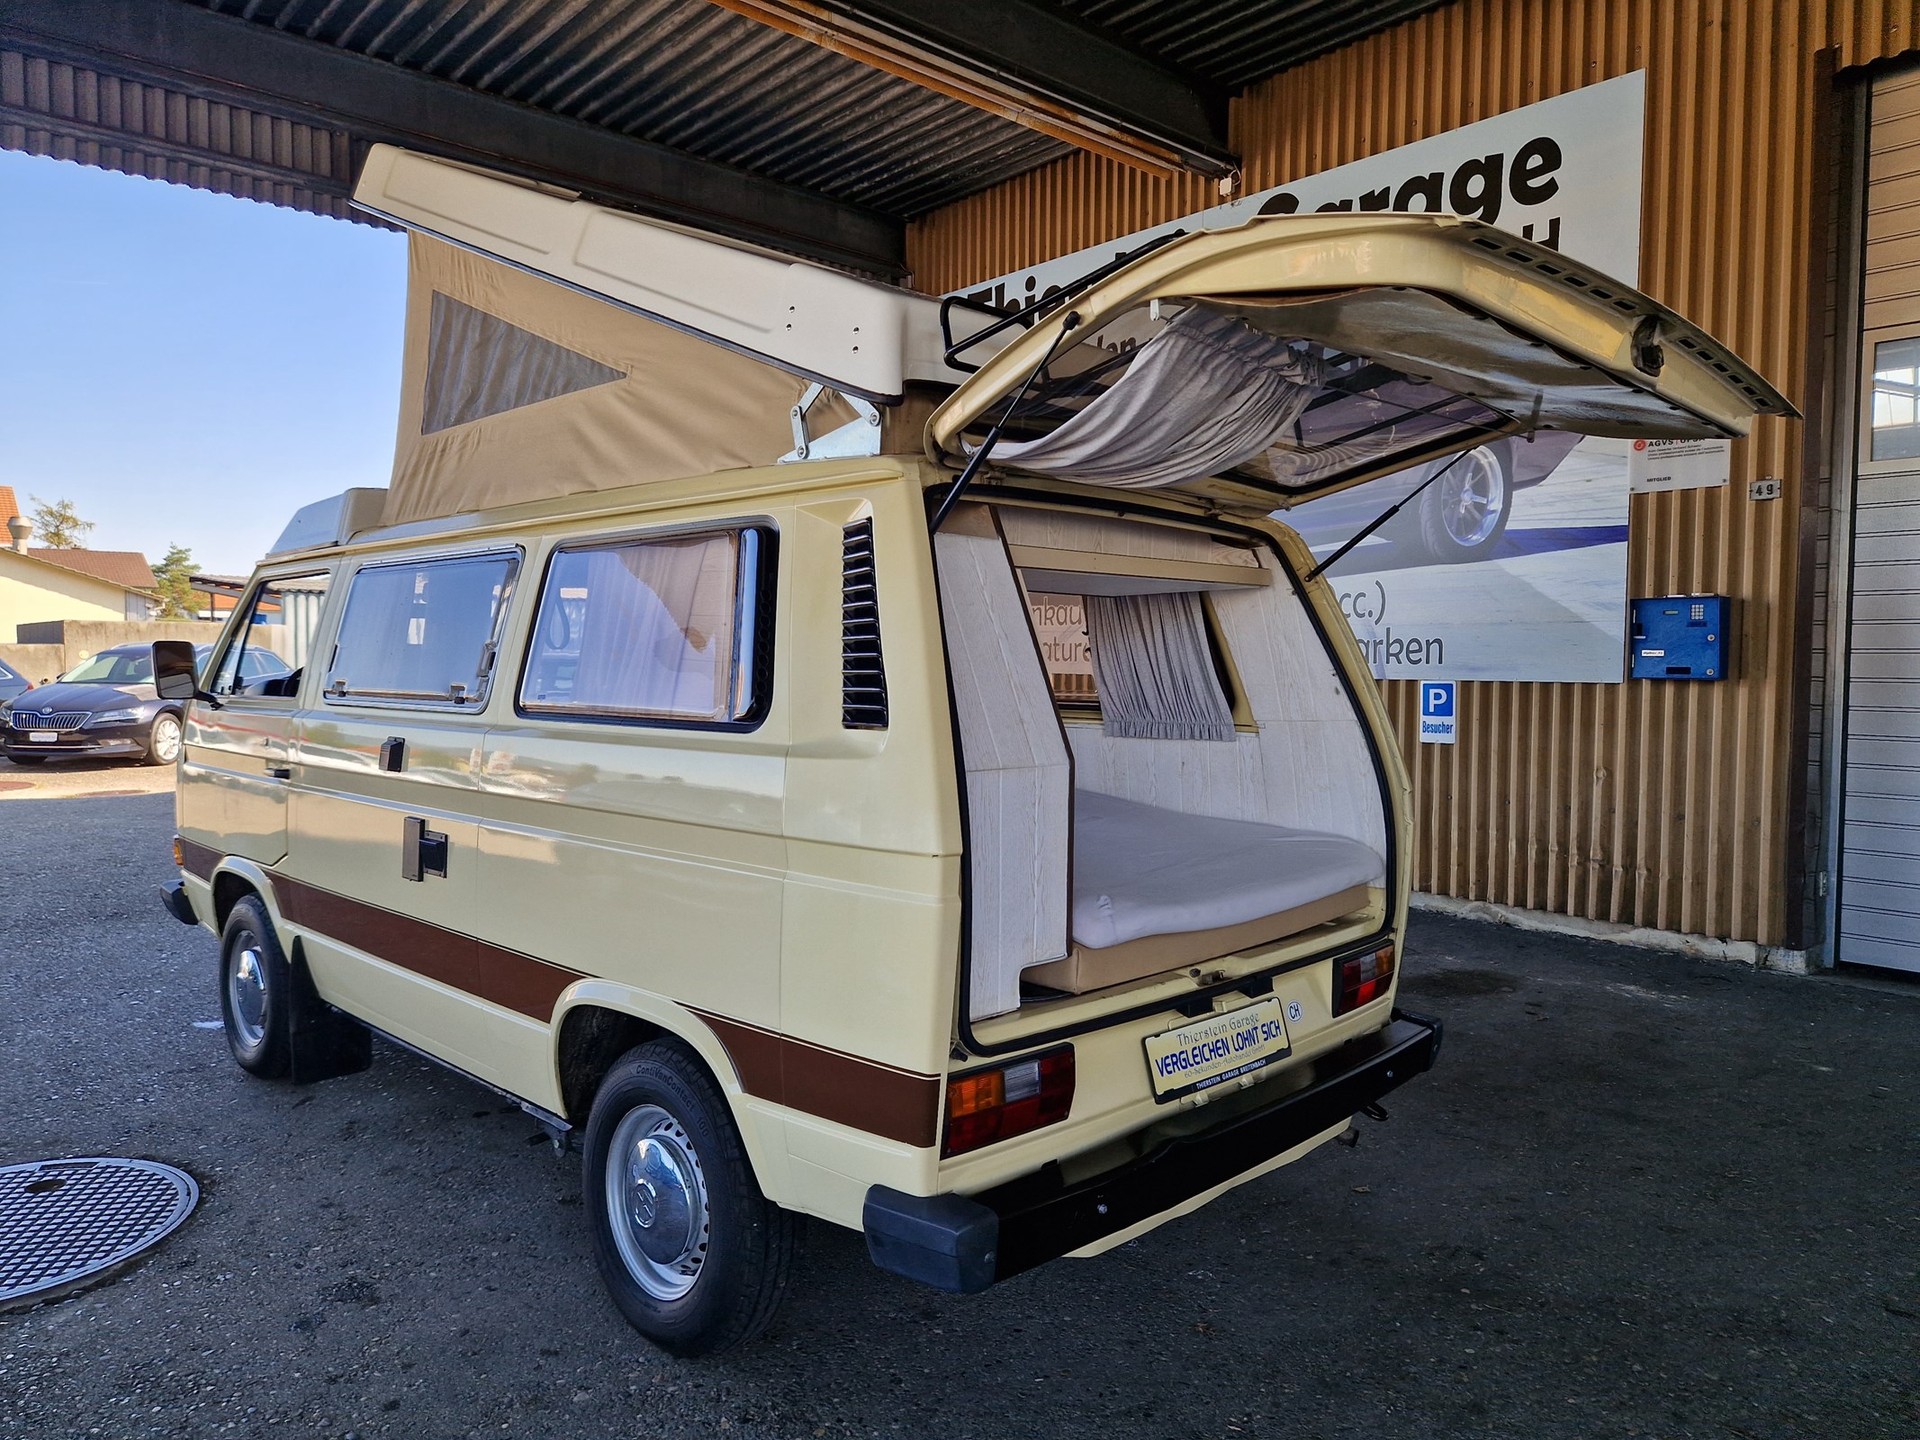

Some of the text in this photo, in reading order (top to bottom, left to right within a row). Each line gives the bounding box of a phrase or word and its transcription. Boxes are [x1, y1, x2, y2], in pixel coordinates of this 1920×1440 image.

[1648, 438, 1674, 448] AGVS
[1755, 484, 1774, 496] 49
[1357, 627, 1444, 665] arken
[1428, 688, 1448, 713] P
[1422, 720, 1454, 734] Besucher
[1288, 1003, 1301, 1020] CH
[1177, 1012, 1261, 1047] Thierstein Garage
[1155, 1019, 1282, 1077] VERGLEICHEN LOHNT SICH
[636, 1064, 696, 1112] ContiVanContact
[1196, 1075, 1222, 1090] THIERSTEIN
[1222, 1068, 1240, 1081] GARAGE
